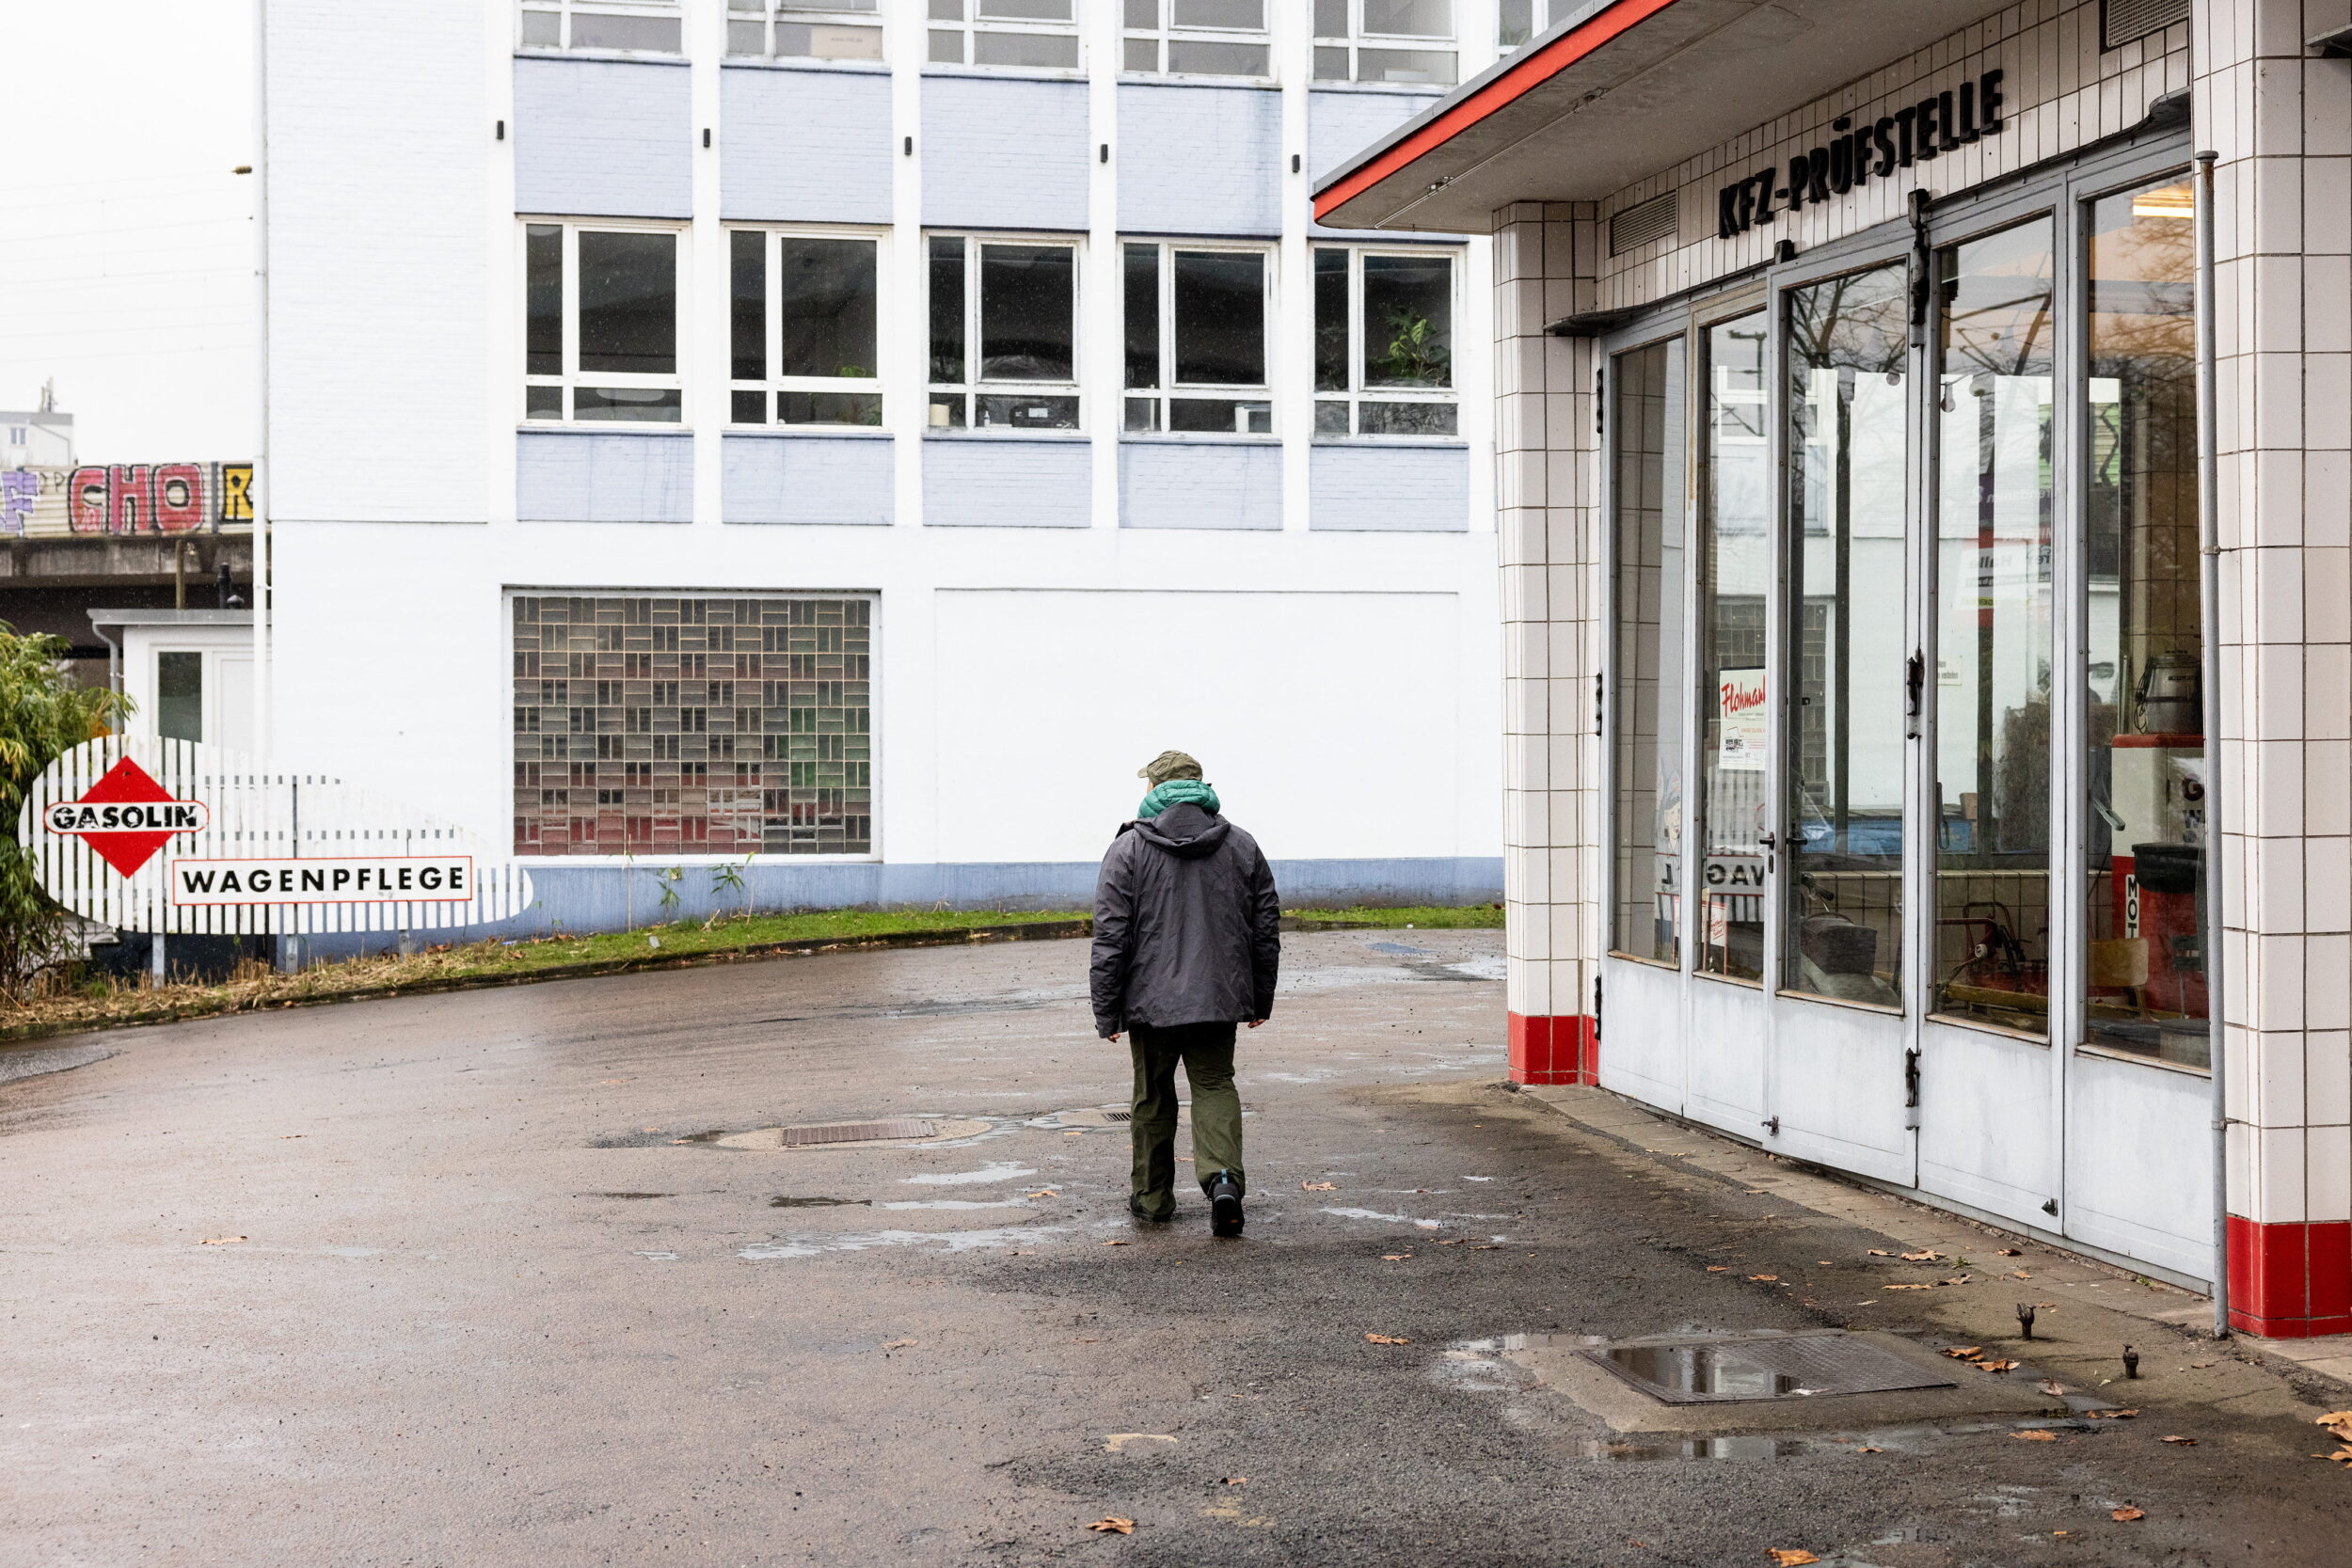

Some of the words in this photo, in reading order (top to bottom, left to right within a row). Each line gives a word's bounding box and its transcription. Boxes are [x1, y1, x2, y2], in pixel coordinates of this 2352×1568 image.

[1719, 69, 2003, 239] KFZ-PRÜFSTELLE
[53, 806, 197, 830] GASOLIN
[183, 866, 463, 893] WAGENPFLEGE
